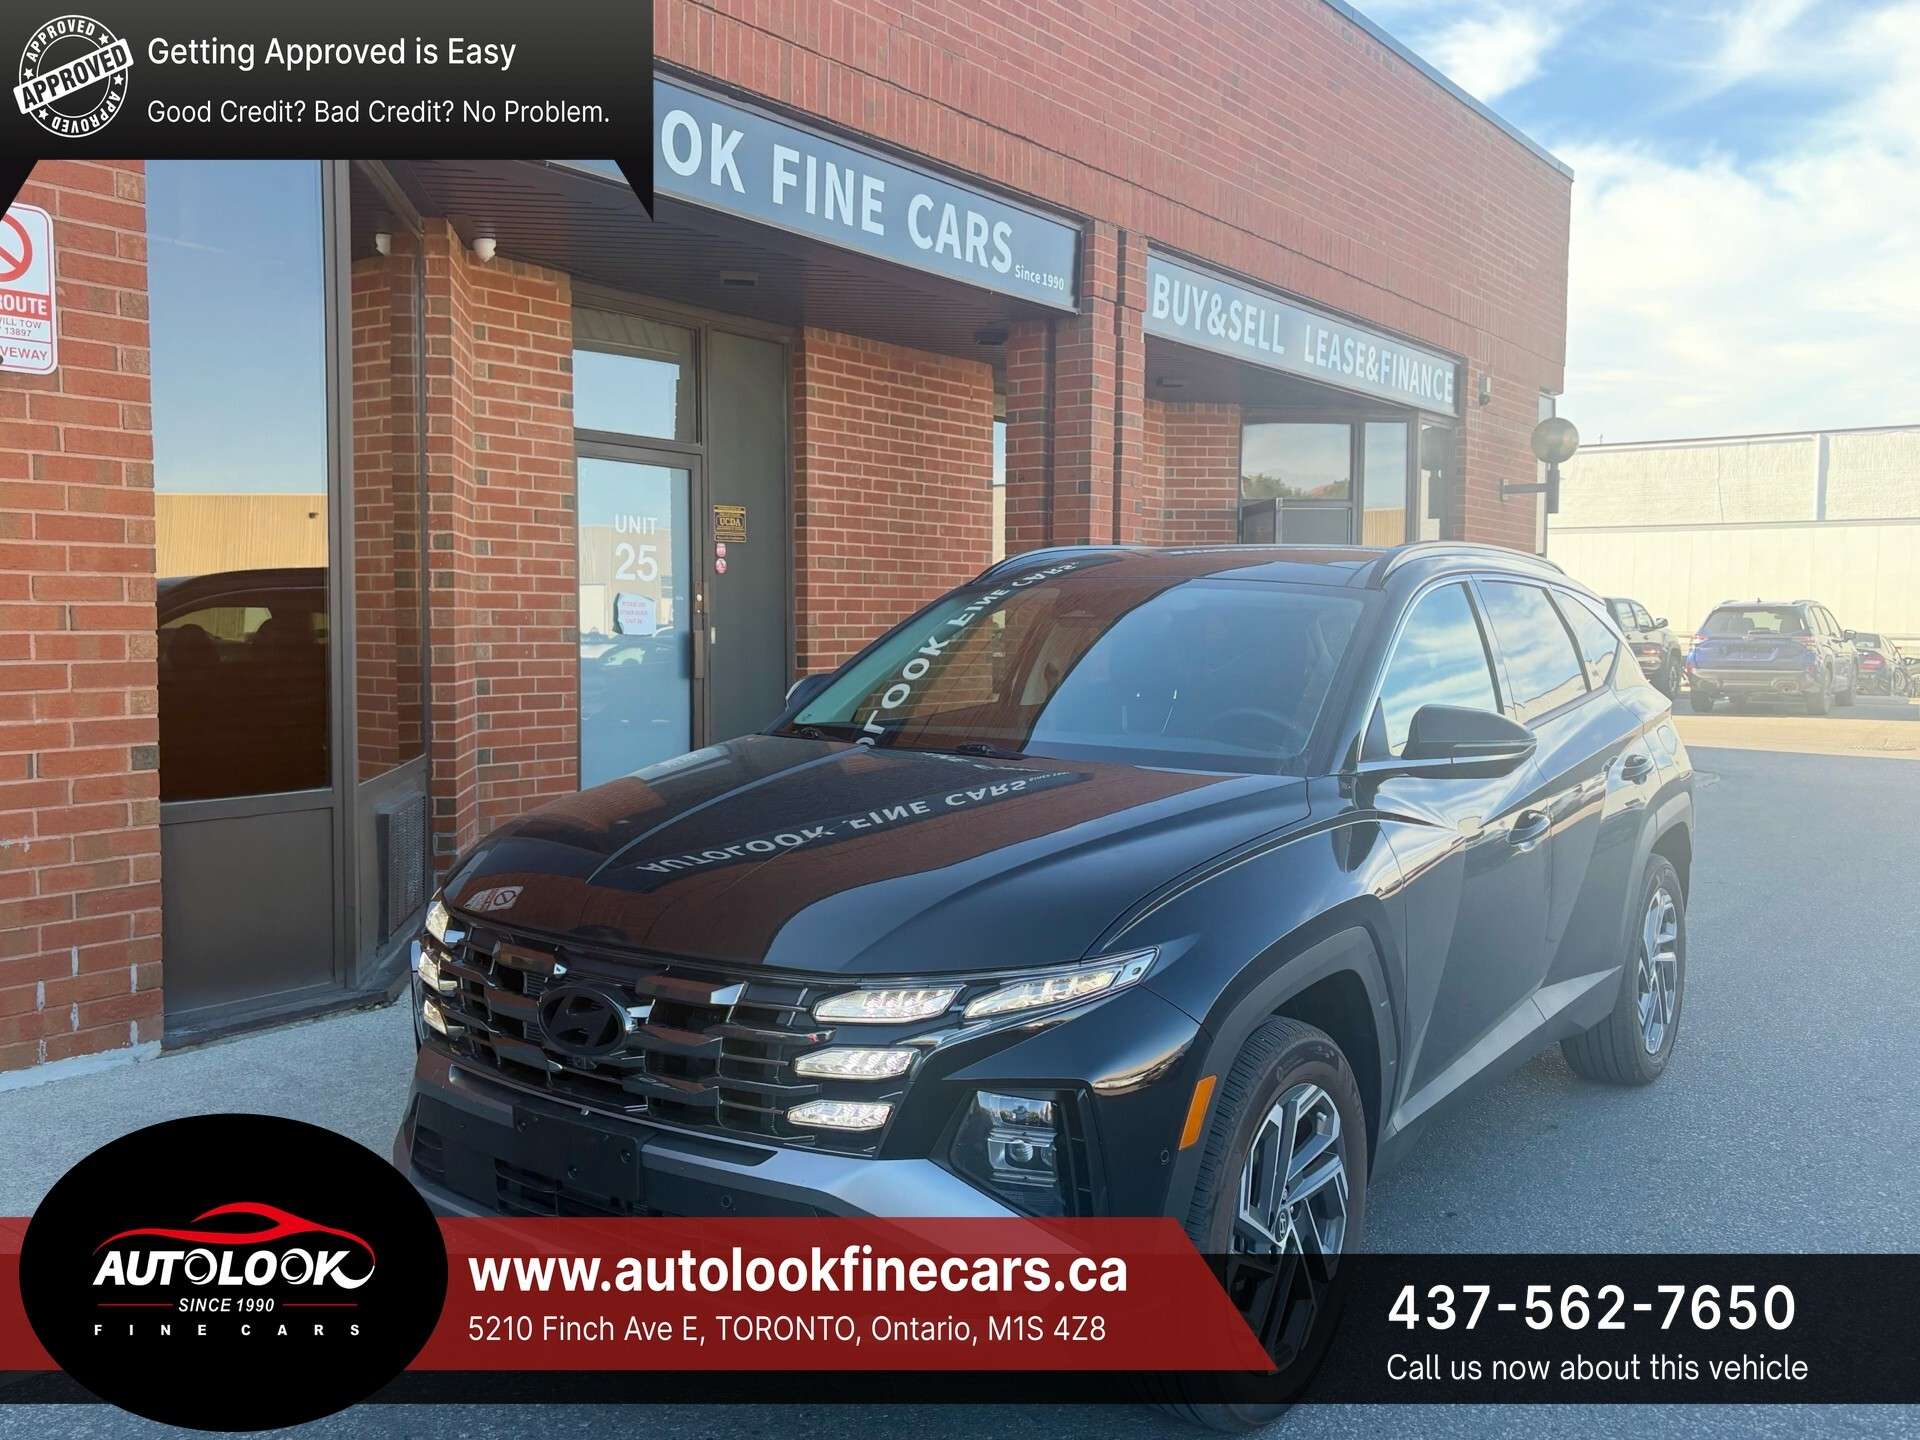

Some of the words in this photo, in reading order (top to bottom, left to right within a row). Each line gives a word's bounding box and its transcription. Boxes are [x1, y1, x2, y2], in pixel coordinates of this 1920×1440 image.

[771, 143, 886, 237] FINE
[907, 193, 1012, 275] CARS
[1014, 264, 1041, 286] Since
[1041, 272, 1065, 292] 1990
[0, 317, 17, 327] ILL
[20, 319, 42, 329] TOW
[1151, 272, 1285, 355] BUY&SELL
[5, 327, 32, 337] 13897
[1303, 324, 1454, 404] LEASE&FINANCE
[614, 514, 658, 536] UNIT
[614, 542, 659, 582] 25
